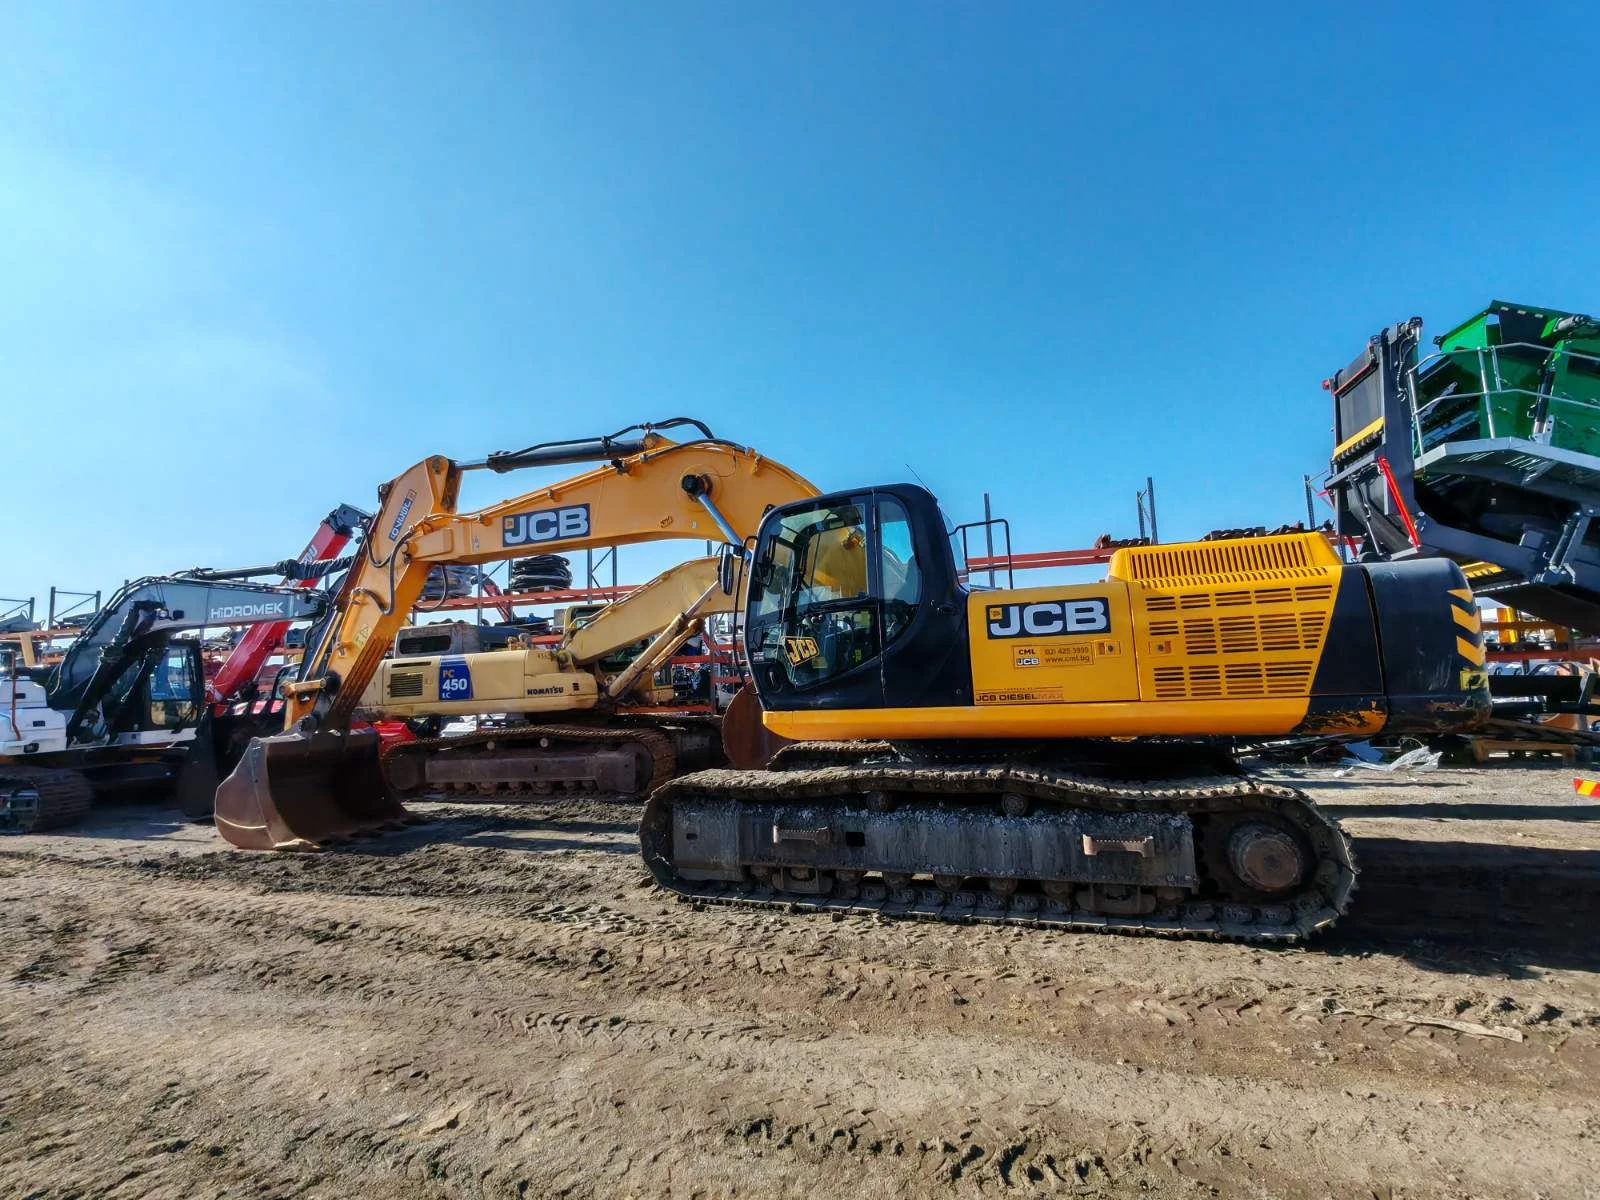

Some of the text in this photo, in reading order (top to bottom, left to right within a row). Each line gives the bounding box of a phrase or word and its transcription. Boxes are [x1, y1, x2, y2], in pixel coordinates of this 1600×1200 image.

[504, 507, 588, 544] JCB
[990, 600, 1107, 636] JCB
[787, 639, 817, 664] JCB
[1018, 648, 1036, 656] CML
[1017, 657, 1039, 666] JCB
[442, 669, 455, 678] PC
[442, 678, 468, 691] 450
[527, 686, 564, 696] KOMATSU
[975, 693, 997, 703] JCB
